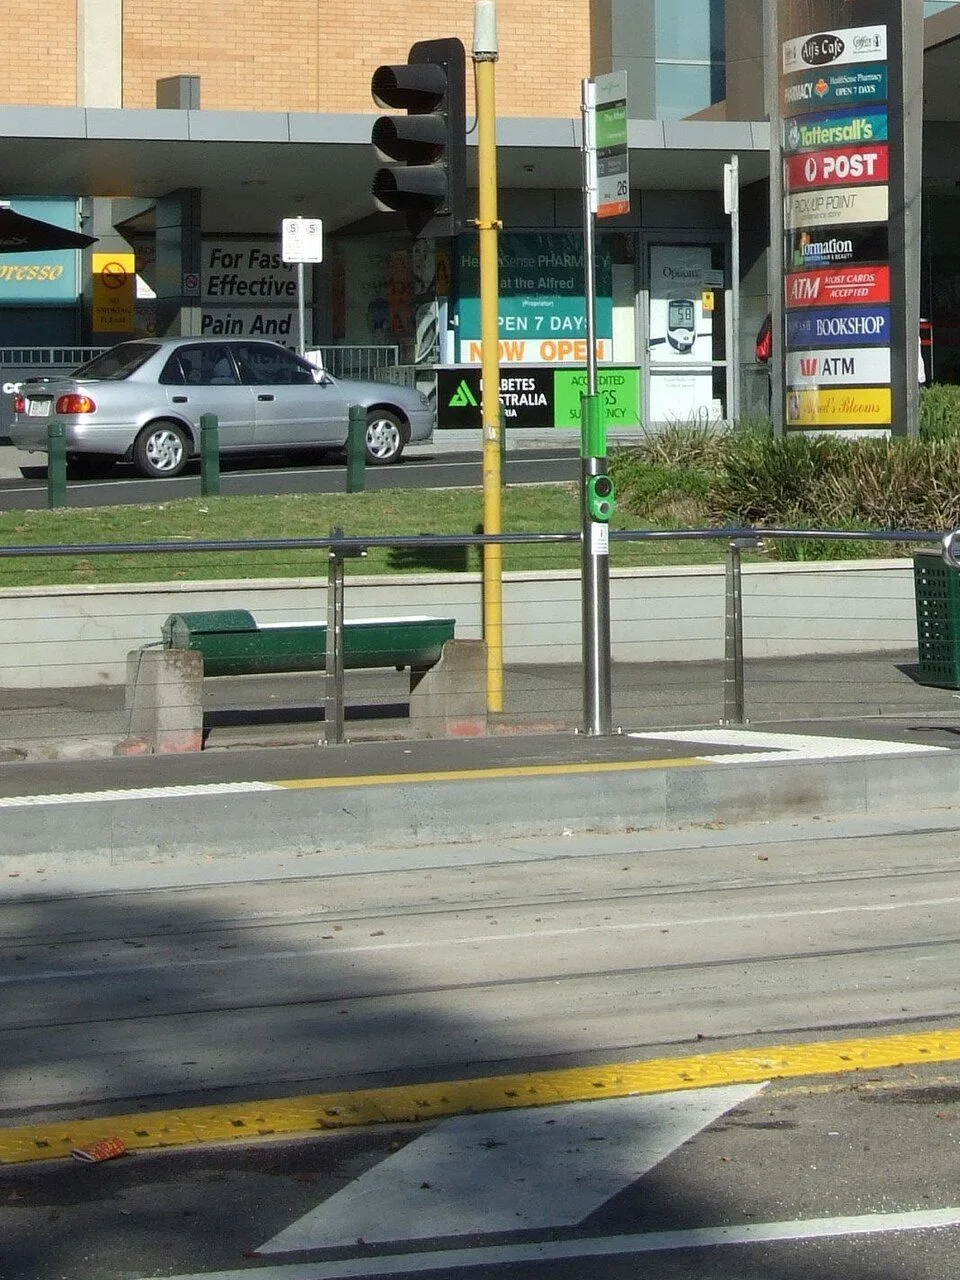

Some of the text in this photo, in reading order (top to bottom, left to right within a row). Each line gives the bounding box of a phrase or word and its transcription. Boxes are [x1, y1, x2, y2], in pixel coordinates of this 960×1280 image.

[835, 87, 853, 97] OPEN
[858, 84, 876, 94] DAYS
[800, 118, 873, 146] Tattersall's
[823, 153, 878, 179] POST
[617, 180, 628, 196] 26
[825, 194, 857, 209] POINT
[210, 248, 295, 271] For Fas,
[538, 255, 610, 268] PHARMCY
[207, 274, 297, 296] Effective
[501, 276, 574, 289] at the Alfred
[824, 274, 876, 284] MOST CARDS
[791, 277, 821, 300] ATM
[829, 287, 870, 298] ACCEPTED
[201, 313, 292, 335] Pain And
[498, 316, 528, 331] PEN
[534, 316, 544, 331] 7
[816, 315, 885, 336] BOOKSHOP
[822, 357, 855, 376] ATM
[480, 378, 535, 391] BETES
[480, 393, 547, 406] STRALIA
